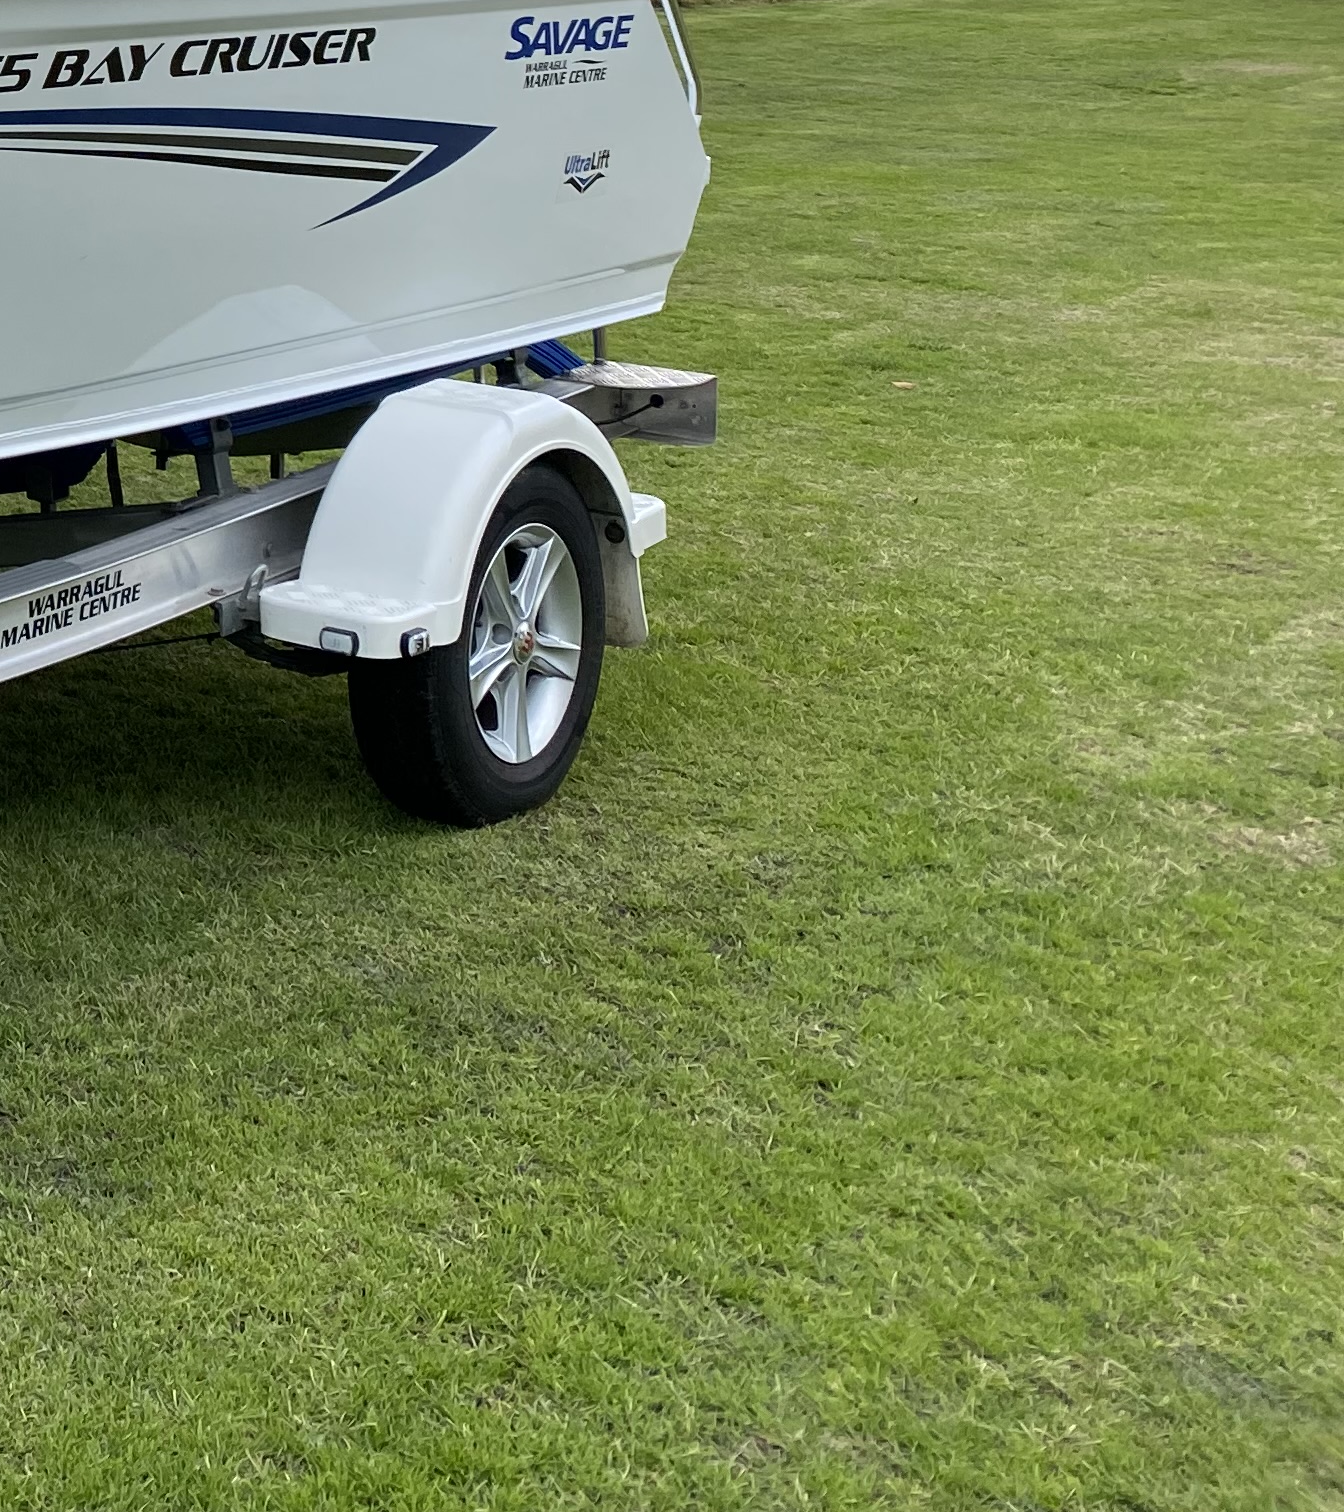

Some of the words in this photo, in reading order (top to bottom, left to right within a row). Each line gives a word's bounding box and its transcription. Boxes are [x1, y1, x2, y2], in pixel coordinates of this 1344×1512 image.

[41, 43, 166, 90] BAY
[169, 27, 377, 78] CRUISER
[504, 14, 635, 61] SAVAGE
[523, 71, 567, 89] MARINE
[568, 67, 608, 84] CENTRE
[564, 149, 610, 175] UltraLift
[0, 607, 74, 650] MARINE
[79, 582, 142, 622] CENTRE
[28, 569, 125, 618] WARRAGUL
